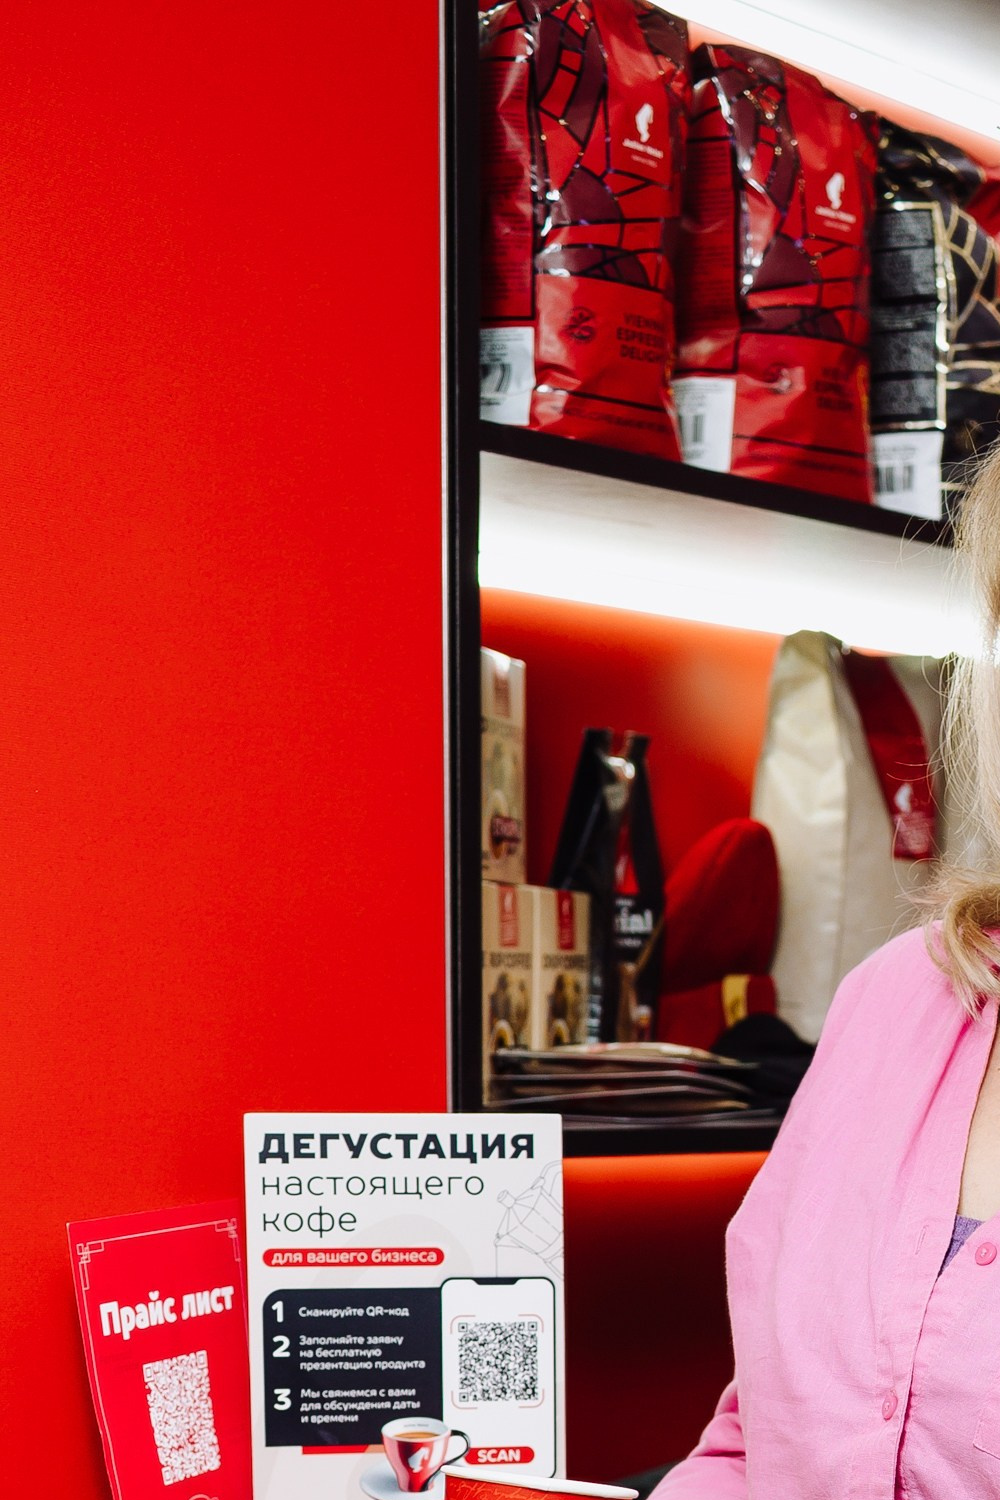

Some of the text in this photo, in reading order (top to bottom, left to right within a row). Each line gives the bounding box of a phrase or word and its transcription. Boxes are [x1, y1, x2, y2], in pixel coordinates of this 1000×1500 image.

[259, 1132, 535, 1164] ДЕГУСТАЦИЯ
[262, 1175, 485, 1200] настоящего
[262, 1205, 358, 1238] кофе
[271, 1248, 438, 1266] для вашего бизнеса
[99, 1285, 235, 1341] Прайс лист
[271, 1300, 410, 1323] 1 Сканируйте QR-код
[272, 1334, 404, 1358] 2 Заполняйте заявку
[299, 1347, 382, 1358] на бесплатную
[299, 1359, 426, 1372] презентацию продукта
[273, 1387, 416, 1411] 3 Мы свяжемся с вами
[299, 1400, 421, 1412] для обсуждения даты
[300, 1413, 359, 1425] и времени
[476, 1448, 522, 1464] SCAN
